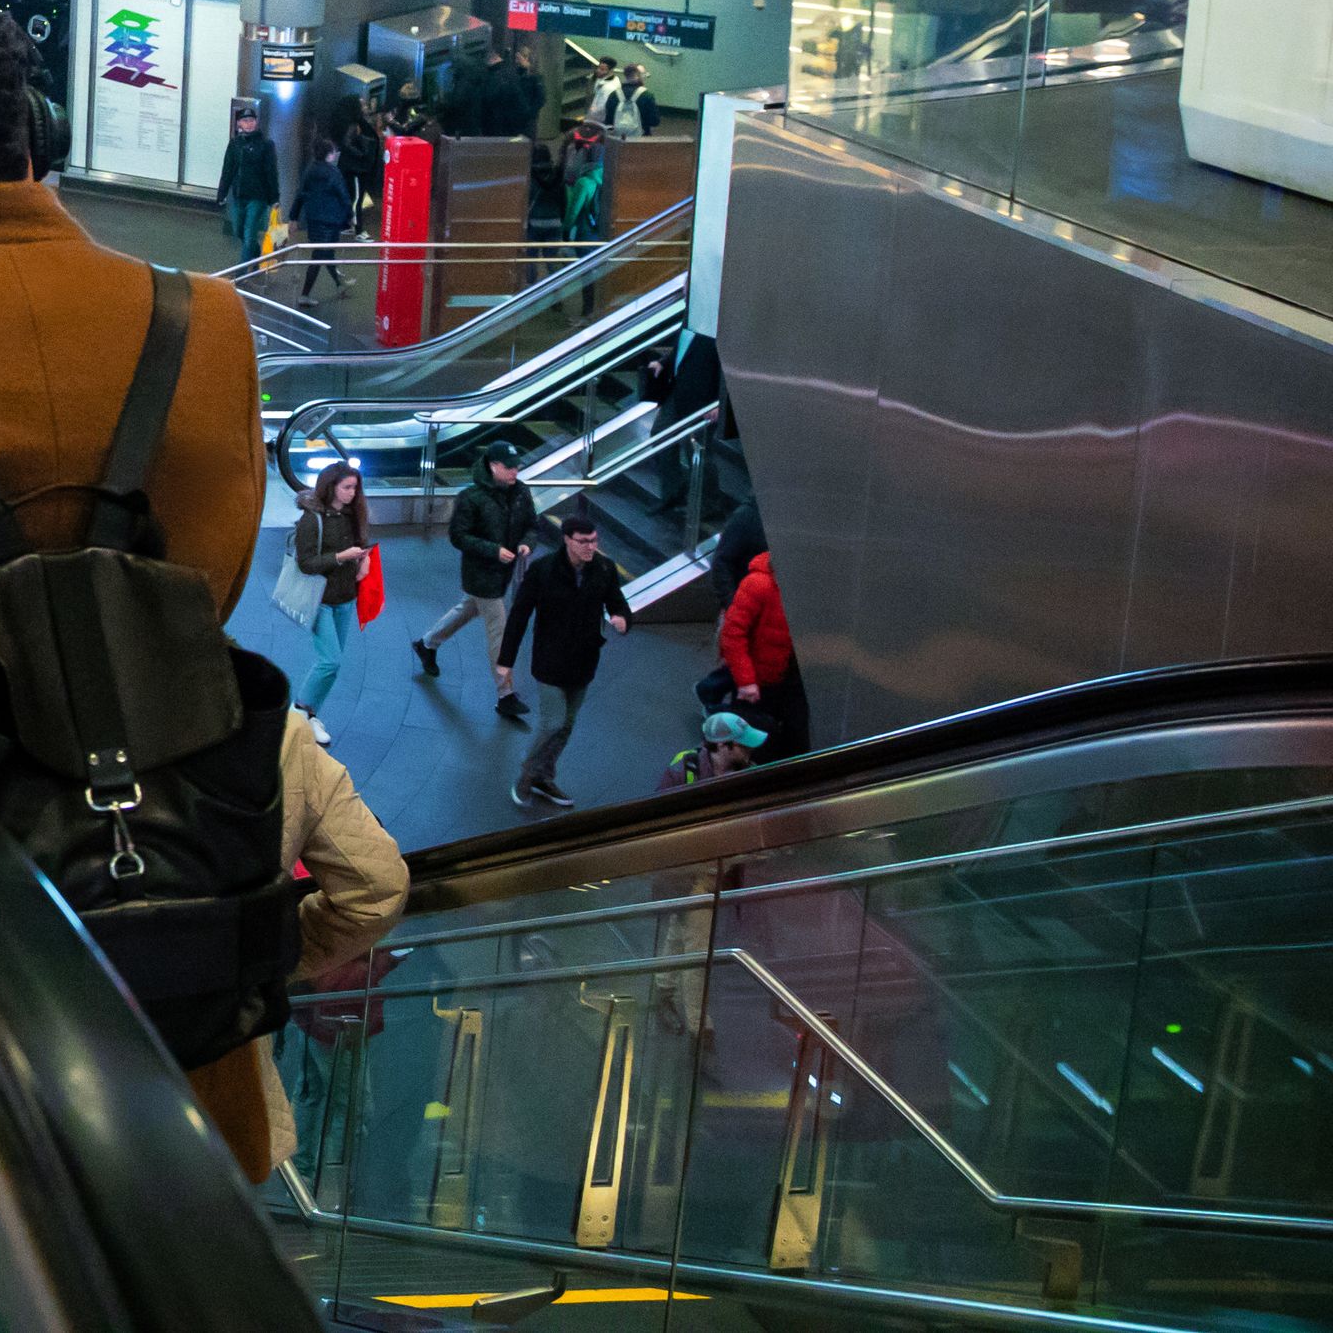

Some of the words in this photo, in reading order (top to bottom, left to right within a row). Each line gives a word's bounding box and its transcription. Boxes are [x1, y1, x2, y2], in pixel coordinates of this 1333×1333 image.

[509, 0, 535, 13] Exit
[538, 3, 561, 14] John
[563, 6, 591, 17] Street
[626, 11, 664, 24] Elevator
[667, 15, 677, 26] to
